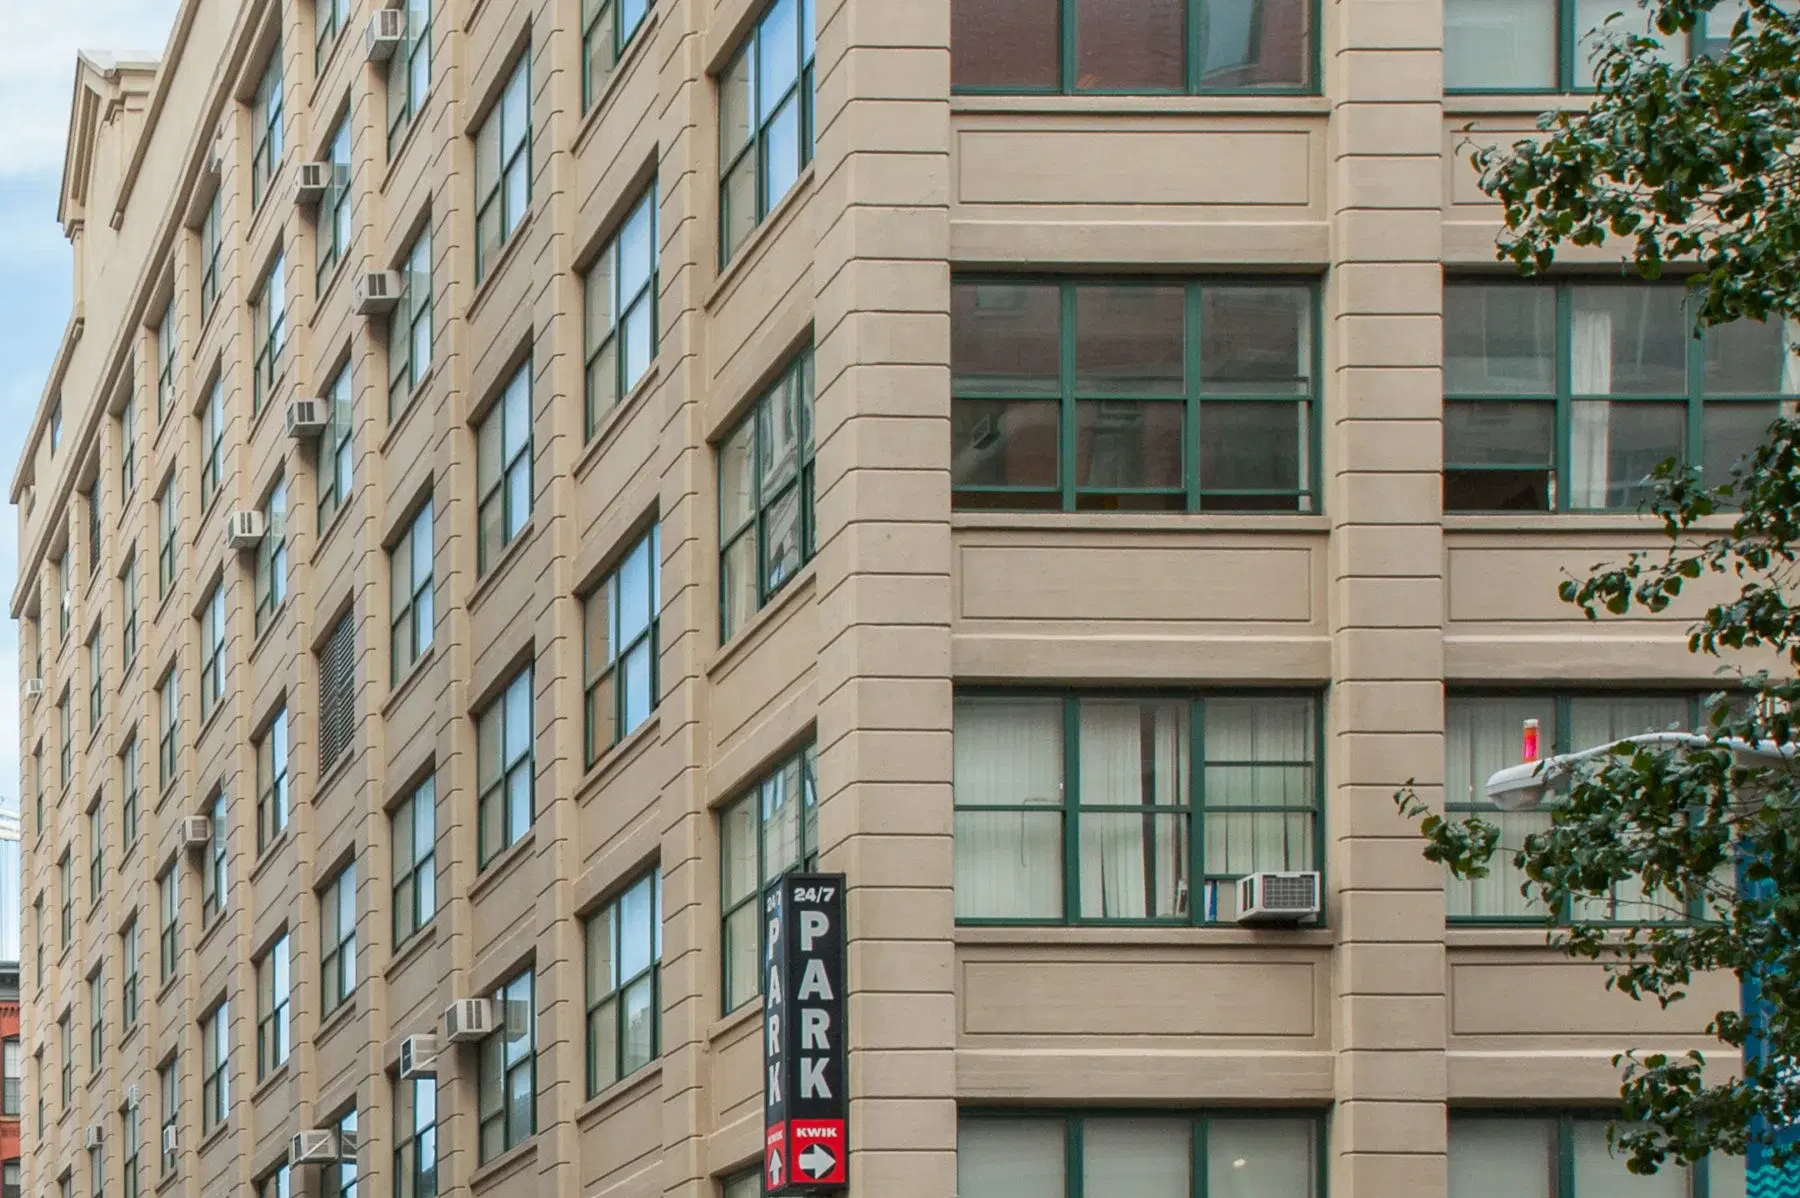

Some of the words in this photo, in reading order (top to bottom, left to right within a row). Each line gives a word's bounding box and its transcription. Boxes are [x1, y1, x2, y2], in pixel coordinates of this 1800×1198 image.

[794, 886, 835, 903] 24/7
[768, 917, 782, 1107] PARK
[797, 910, 834, 1099] PARK
[796, 1127, 837, 1138] KWIK
